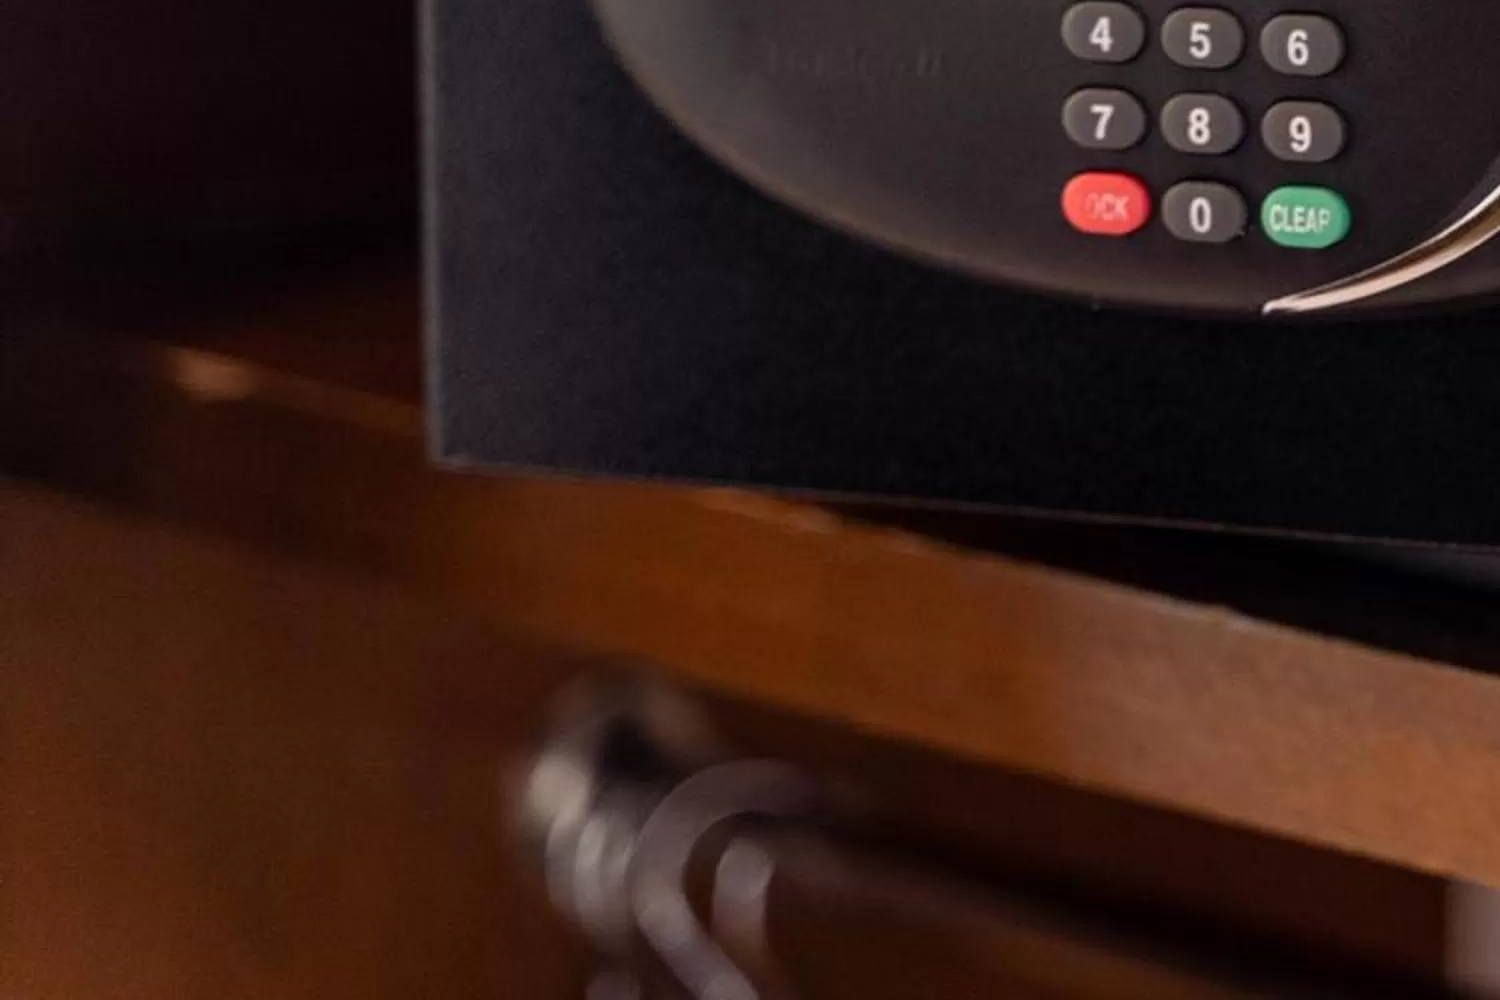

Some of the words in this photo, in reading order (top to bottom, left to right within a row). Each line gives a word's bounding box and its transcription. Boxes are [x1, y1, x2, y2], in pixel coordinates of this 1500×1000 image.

[1089, 16, 1114, 53] 4
[1188, 22, 1213, 59] 5
[1286, 29, 1310, 67] 6
[1089, 103, 1115, 141] 7
[1187, 107, 1212, 145] 8
[1289, 116, 1313, 153] 9
[1189, 197, 1213, 234] 0
